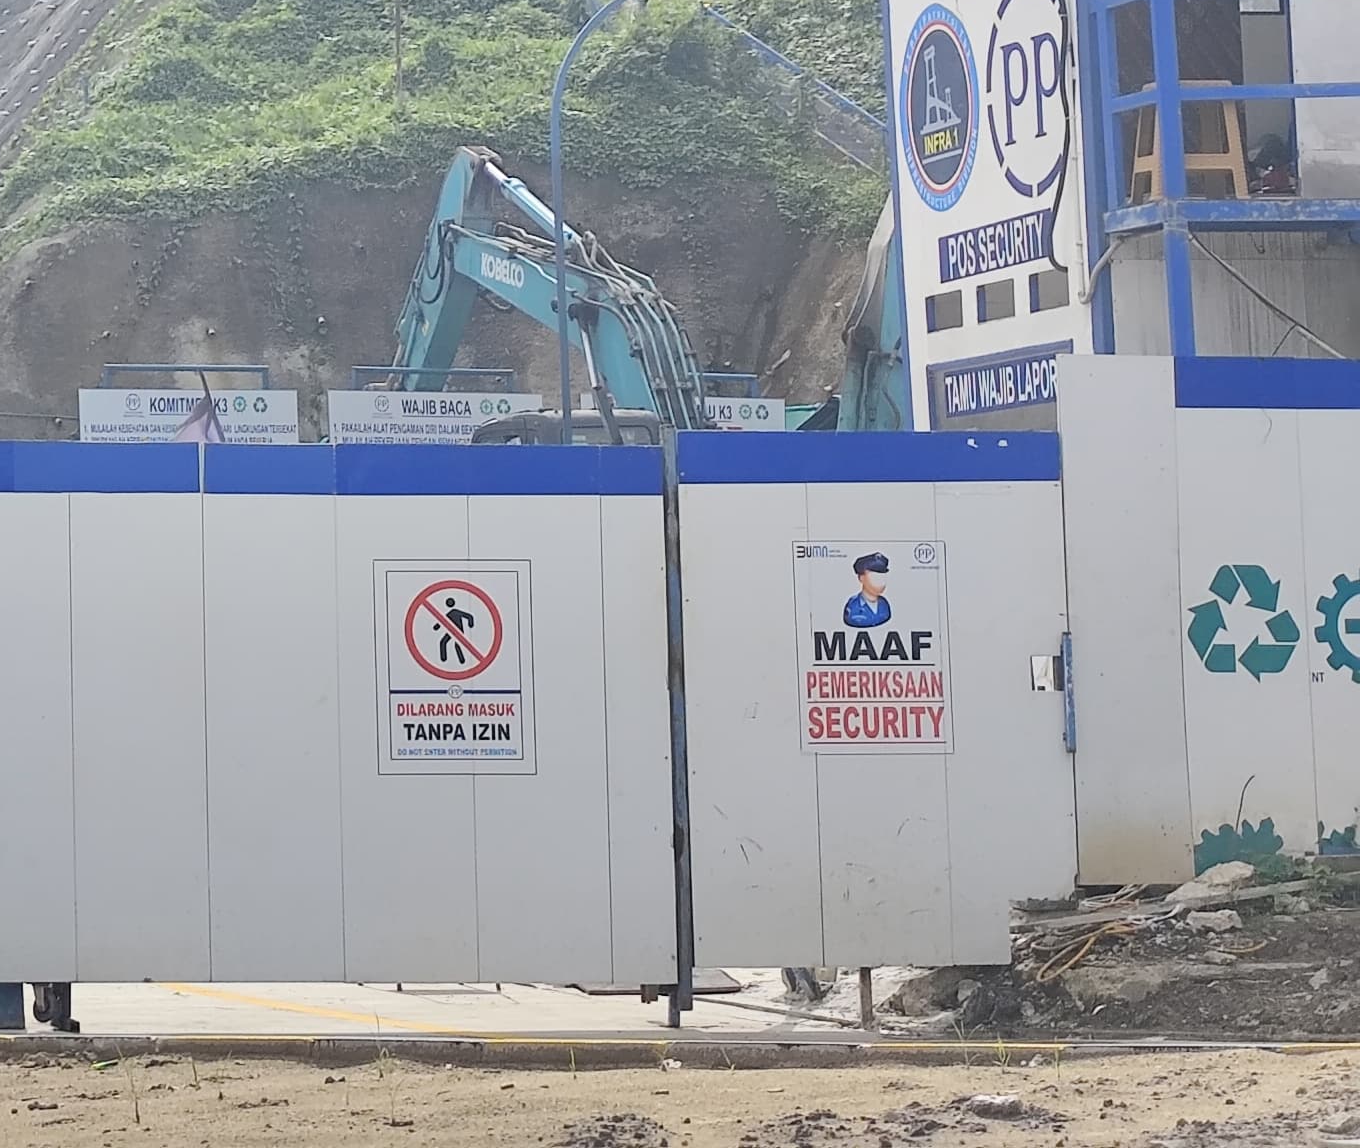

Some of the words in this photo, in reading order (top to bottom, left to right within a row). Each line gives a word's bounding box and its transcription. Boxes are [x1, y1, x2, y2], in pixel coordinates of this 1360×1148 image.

[924, 128, 952, 156] INFRA
[947, 235, 977, 279] POS
[978, 213, 1044, 274] SECURITY
[481, 252, 524, 288] KOBELCO
[945, 369, 978, 414] TAMU
[978, 365, 1016, 409] WAJIB
[149, 397, 205, 413] KOMITME
[213, 397, 228, 413] K3
[401, 399, 437, 415] WAJIB
[439, 400, 472, 416] BACA
[719, 405, 733, 420] K3
[813, 631, 933, 661] MAAF
[806, 671, 944, 699] PEMERIKSAAN
[396, 703, 464, 717] DILARANG
[468, 703, 515, 717] MASUK
[808, 706, 945, 739] SECURITY
[403, 723, 466, 741] TANPA
[472, 723, 511, 741] IZIN
